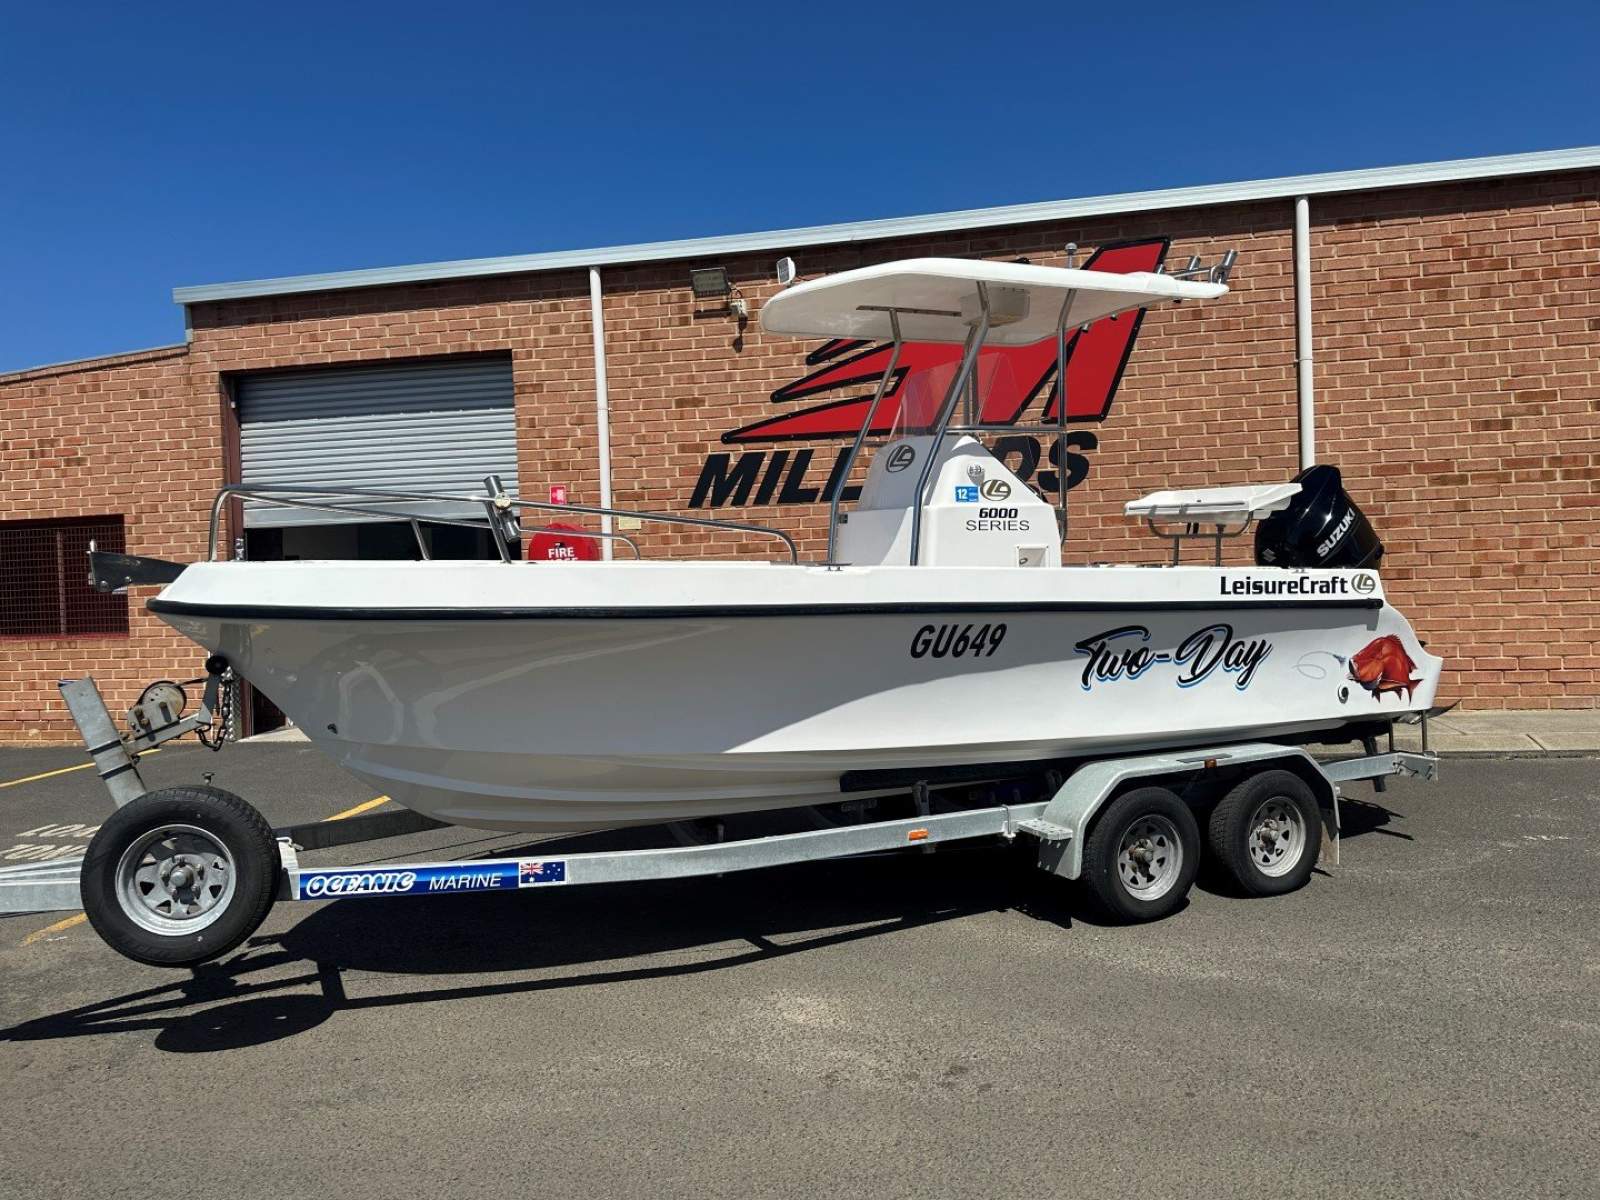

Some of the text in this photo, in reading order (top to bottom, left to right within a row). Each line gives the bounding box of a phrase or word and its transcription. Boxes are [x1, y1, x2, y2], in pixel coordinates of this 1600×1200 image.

[957, 488, 968, 499] 12
[979, 508, 1018, 518] 6000
[966, 520, 1030, 531] SERIES
[1316, 507, 1356, 557] SUZUKI
[547, 547, 575, 558] FIRE
[1220, 576, 1348, 595] LeisureCraft
[910, 623, 1007, 658] GU649
[1073, 623, 1273, 690] Two-Day
[306, 872, 502, 897] OCEANIC MARINE
